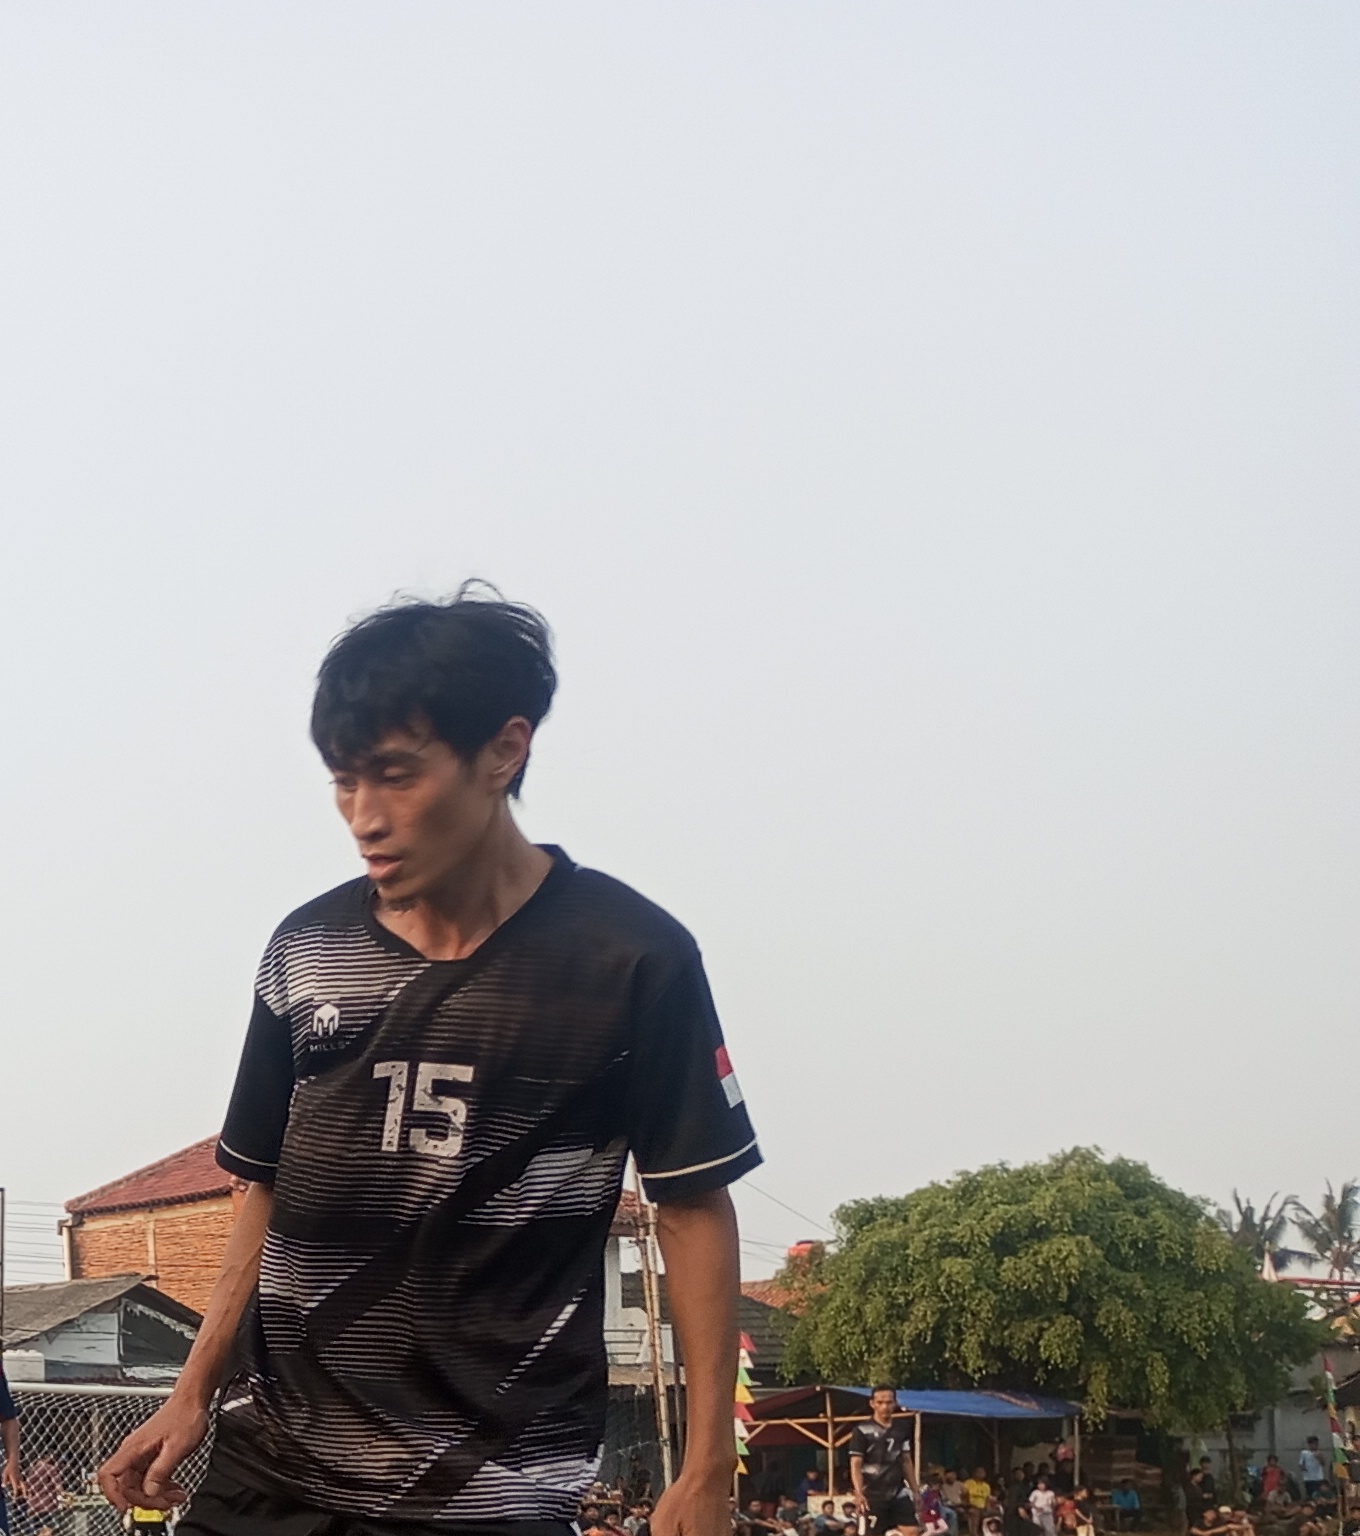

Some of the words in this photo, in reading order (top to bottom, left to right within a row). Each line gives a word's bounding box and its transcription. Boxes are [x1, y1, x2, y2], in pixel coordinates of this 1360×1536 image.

[309, 1041, 347, 1052] MILLS
[372, 1061, 475, 1158] 15
[887, 1438, 895, 1452] 7
[868, 1515, 878, 1528] 7
